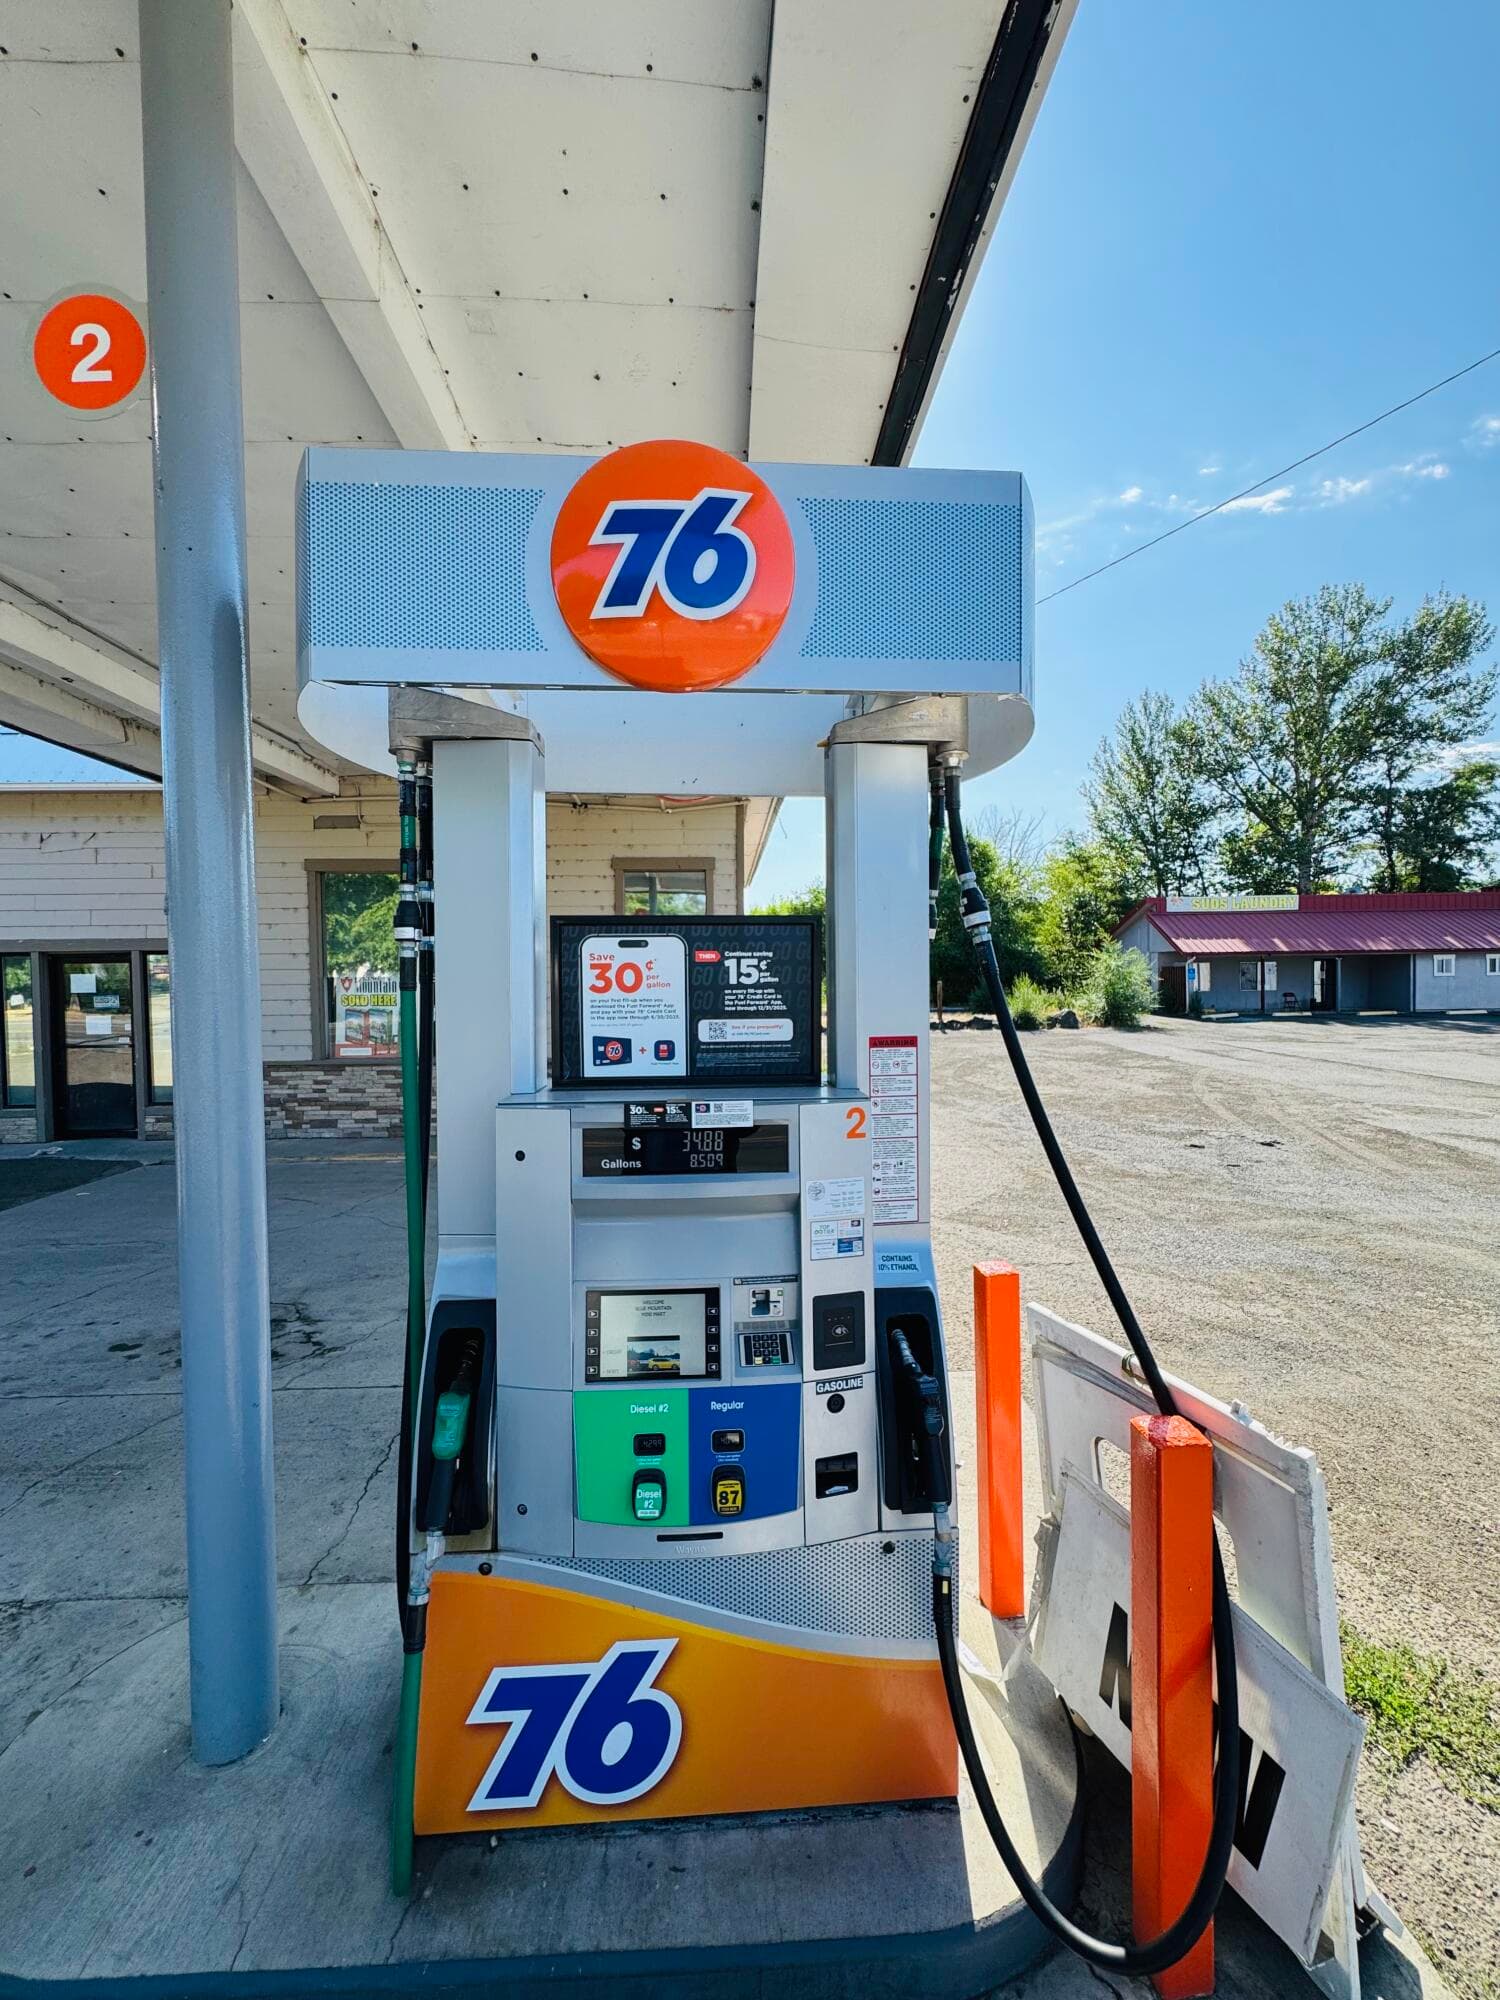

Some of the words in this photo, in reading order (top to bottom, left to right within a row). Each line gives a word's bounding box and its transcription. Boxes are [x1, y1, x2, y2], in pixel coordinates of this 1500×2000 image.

[70, 322, 113, 383] 2
[587, 486, 757, 622] 76
[1192, 897, 1228, 910] SUDS
[1232, 895, 1296, 909] LAUNDRY
[589, 953, 615, 961] Save
[646, 981, 671, 989] gallon
[370, 994, 397, 1007] HERE
[846, 1107, 866, 1139] 2
[632, 1136, 642, 1150] $
[601, 1158, 642, 1169] Gallons
[881, 1254, 913, 1262] CONTAINS
[890, 1263, 918, 1271] ETHANOL
[816, 1377, 863, 1393] GASOLINE
[630, 1404, 657, 1414] Diesel
[658, 1403, 669, 1413] #2
[710, 1400, 744, 1412] Regular
[636, 1488, 662, 1499] Diesel
[719, 1489, 740, 1505] 87
[643, 1499, 655, 1509] #2
[465, 1637, 683, 1812] 76
